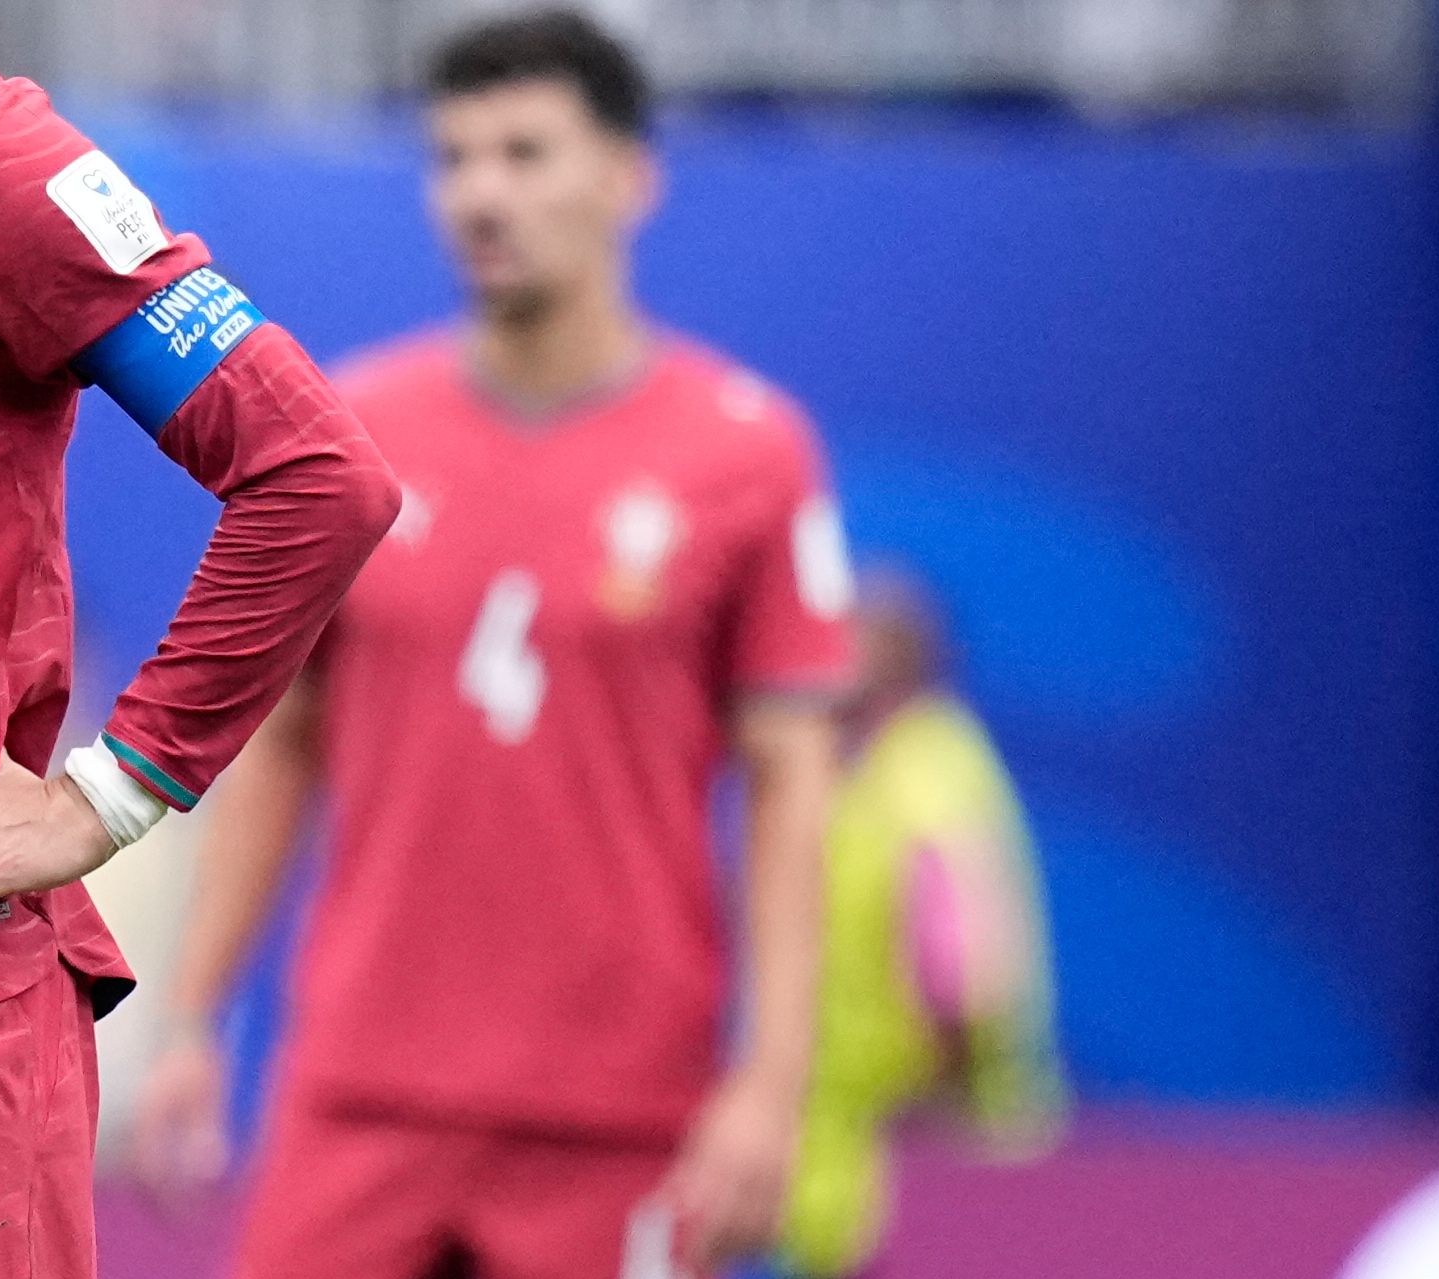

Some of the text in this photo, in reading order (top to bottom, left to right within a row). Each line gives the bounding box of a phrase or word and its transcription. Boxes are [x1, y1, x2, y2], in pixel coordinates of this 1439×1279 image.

[146, 267, 227, 334] UNITES
[168, 322, 206, 358] the
[217, 316, 247, 344] FIFA
[458, 568, 548, 745] 4
